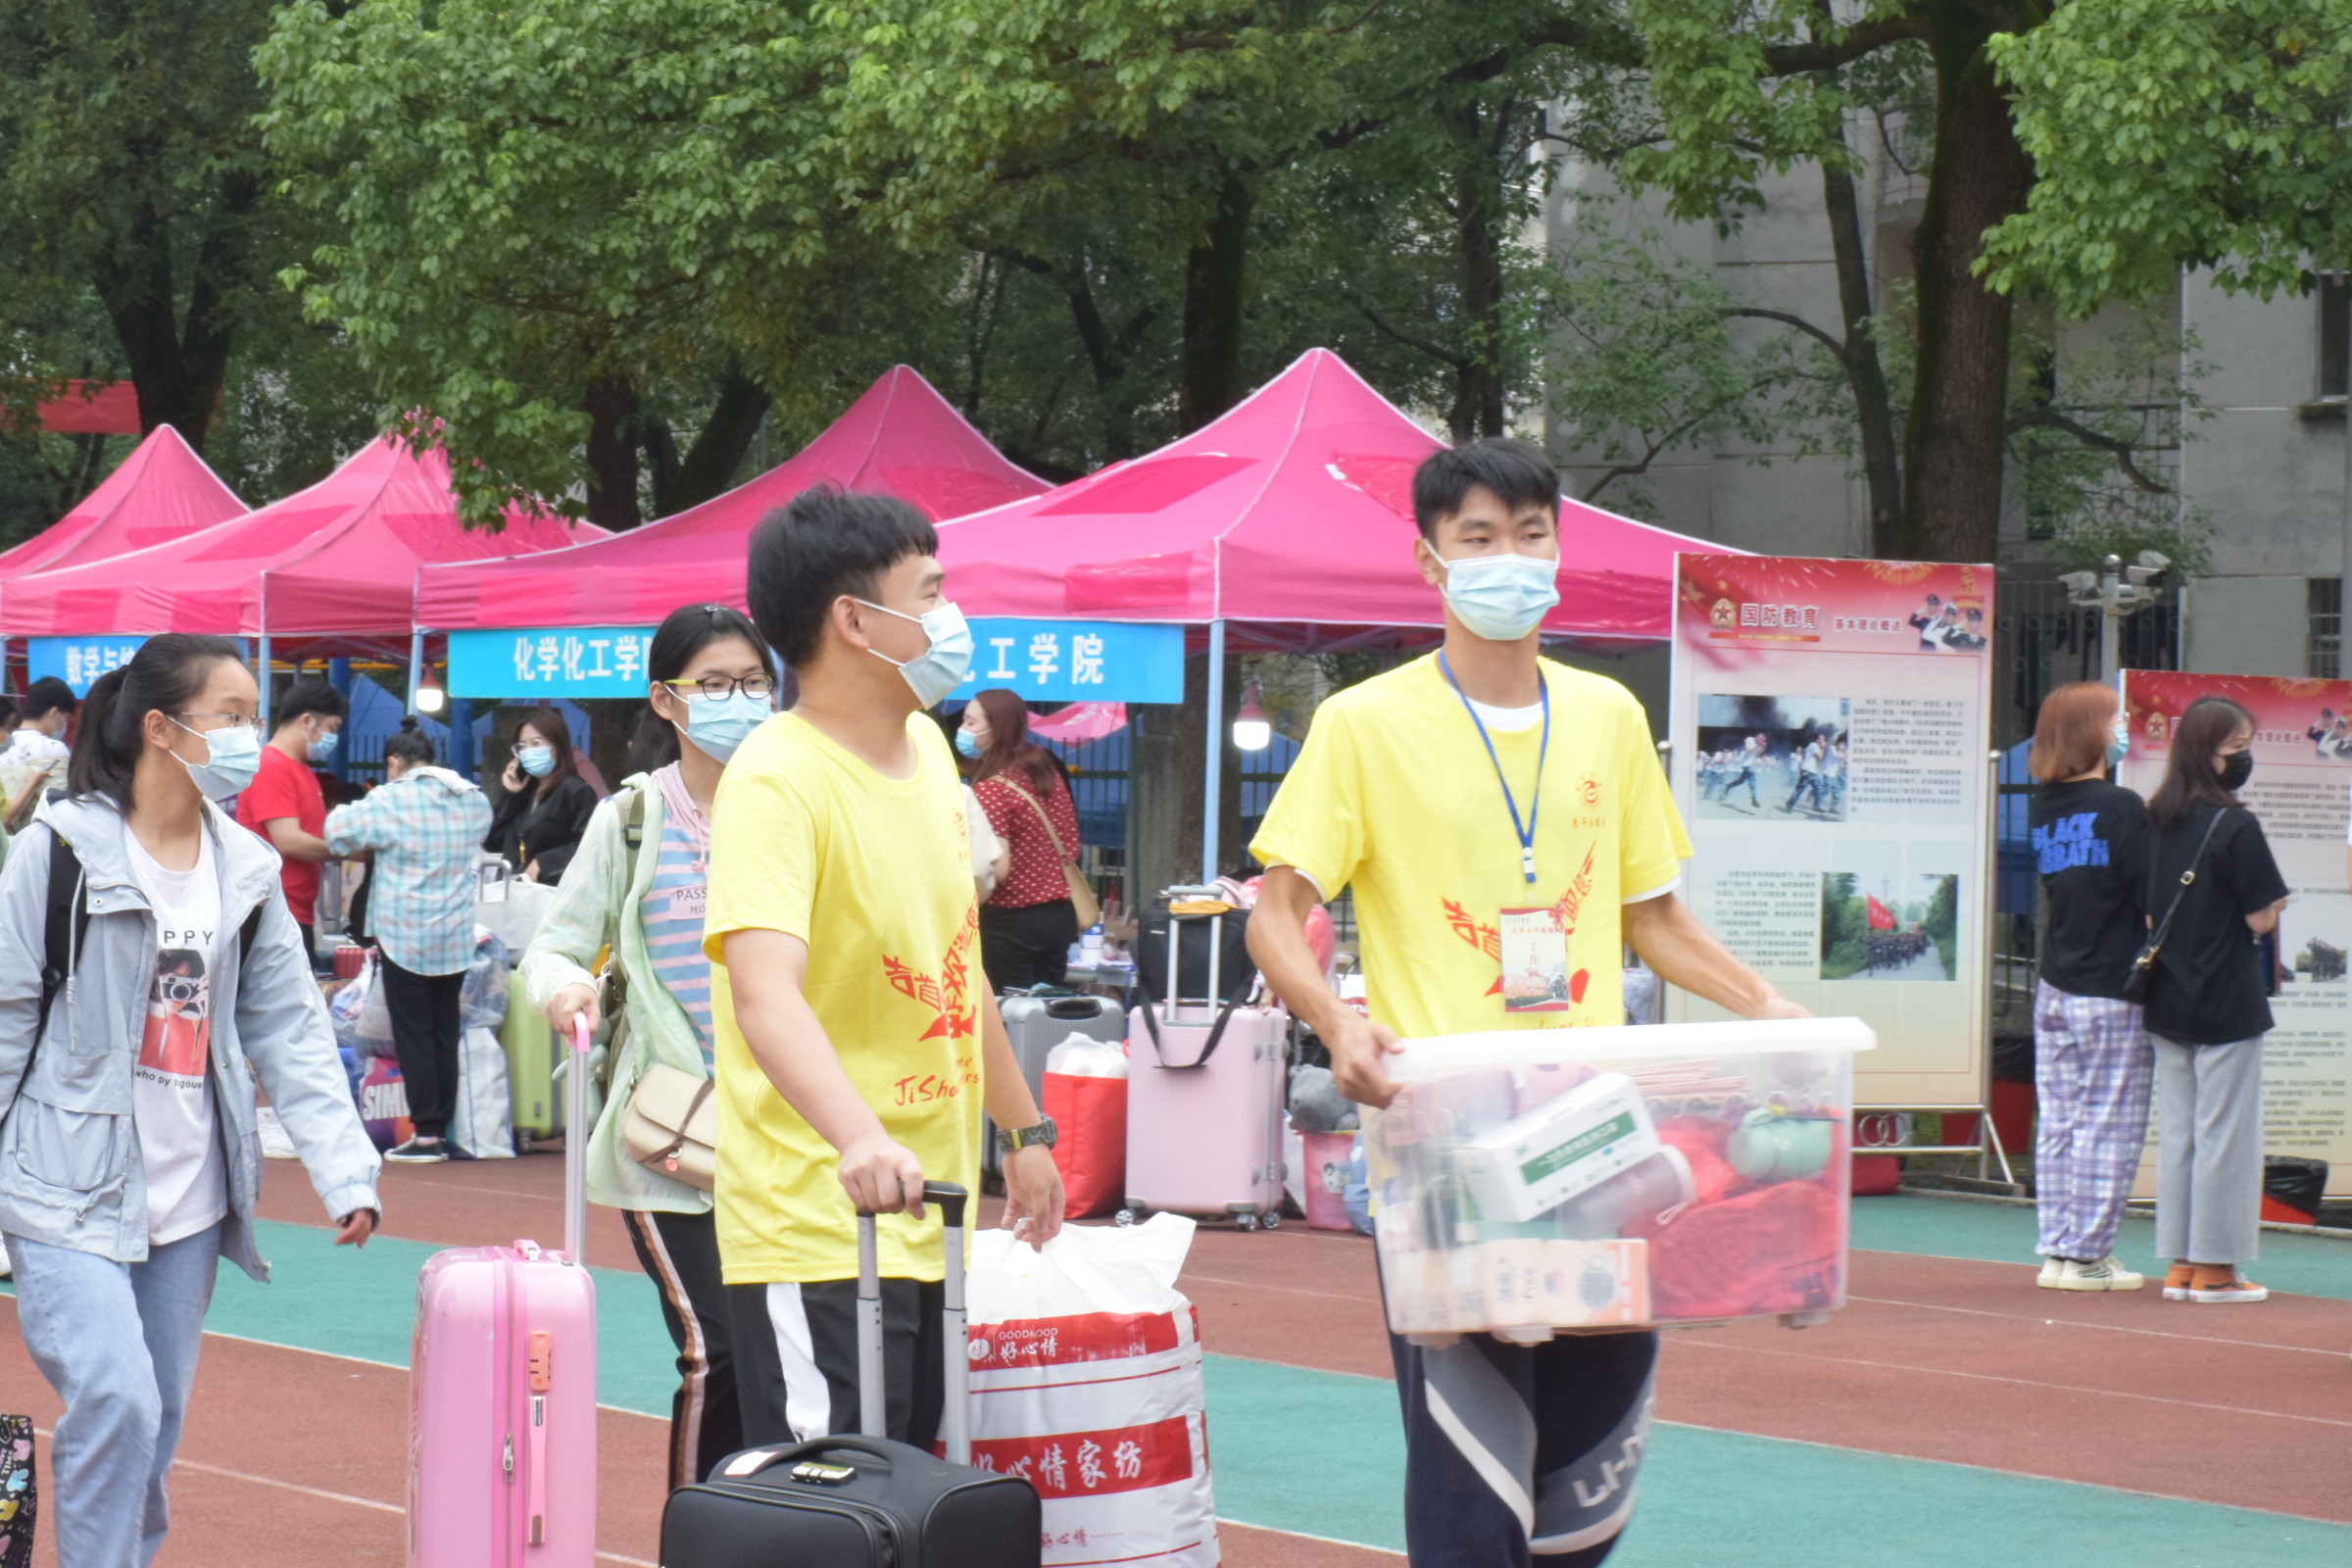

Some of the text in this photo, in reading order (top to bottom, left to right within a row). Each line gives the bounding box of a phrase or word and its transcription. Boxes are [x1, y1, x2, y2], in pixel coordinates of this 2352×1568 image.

[1740, 603, 1820, 629] 国防教育
[961, 633, 1103, 685] 工学院
[2037, 838, 2110, 874] BBATH
[676, 888, 708, 901] PASS
[690, 905, 706, 914] PEO
[164, 930, 214, 946] PPY
[895, 1074, 960, 1105] JiSho
[1000, 1327, 1058, 1340] GOODMOOD
[1001, 1336, 1058, 1367] 好心情
